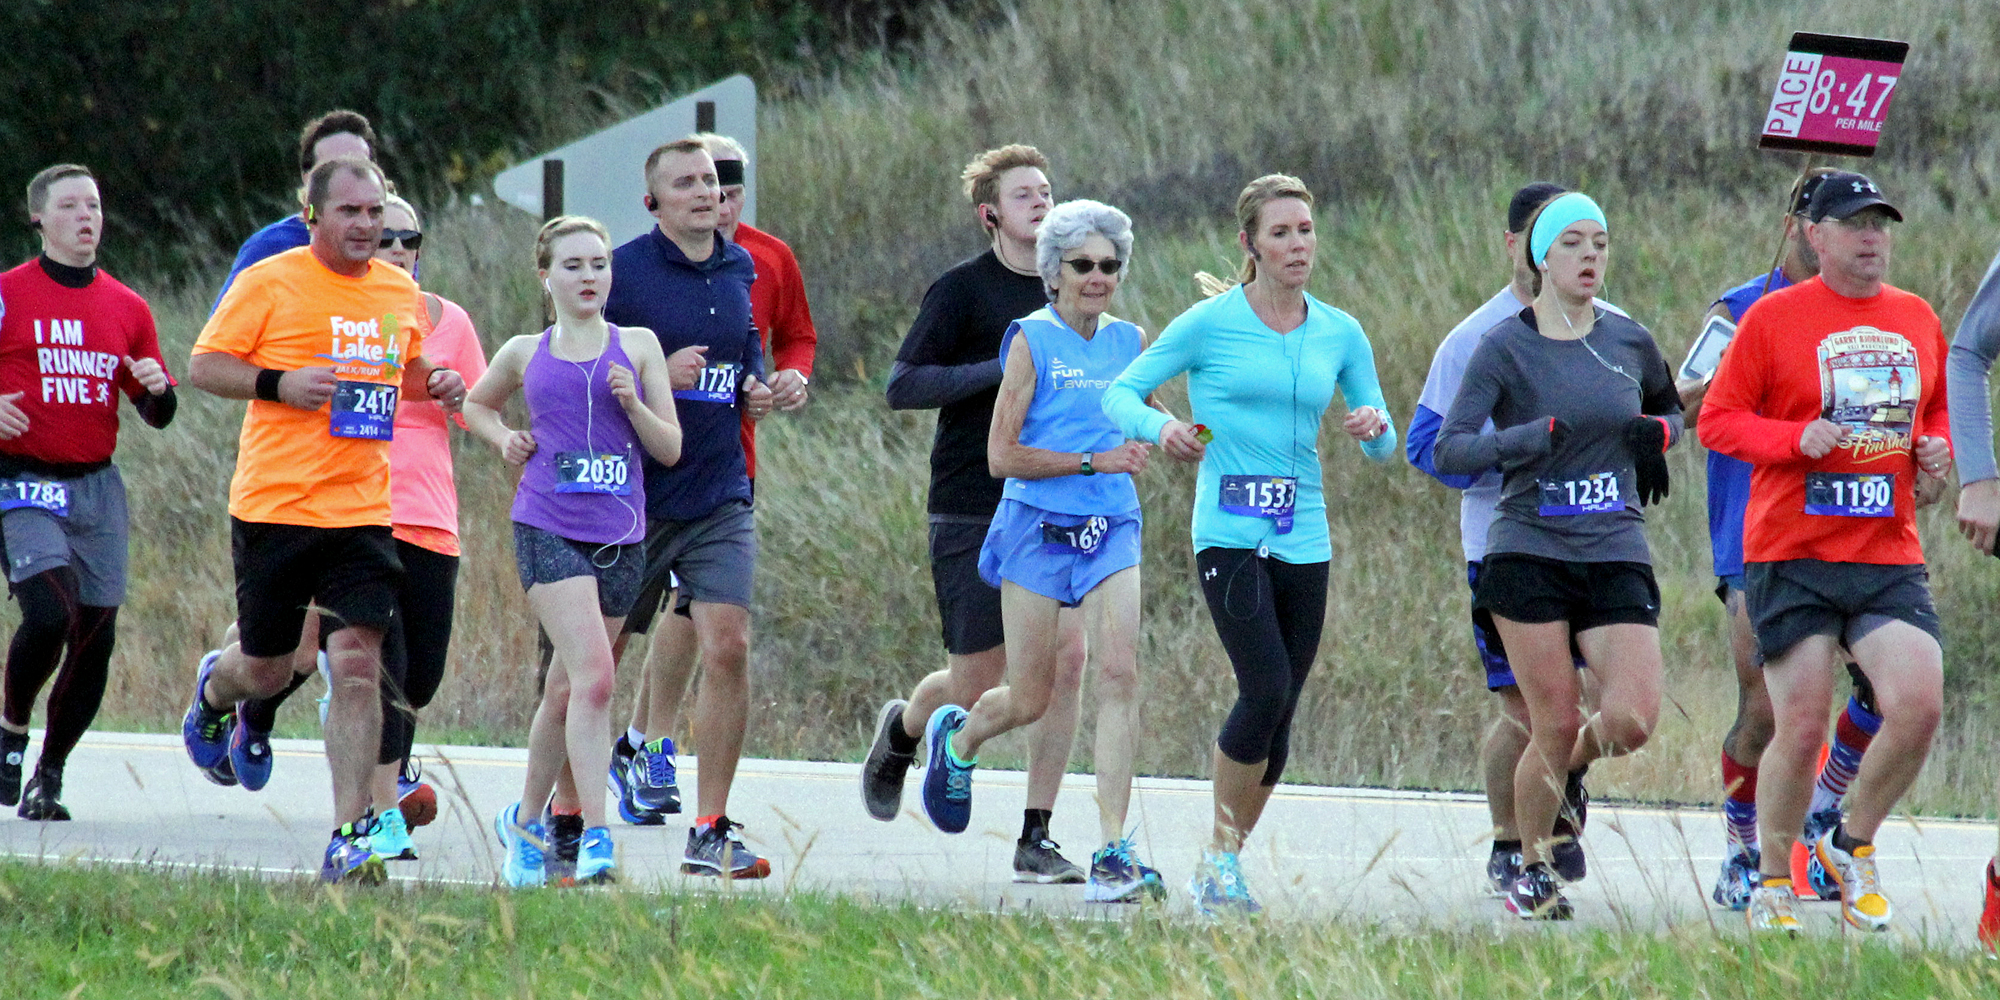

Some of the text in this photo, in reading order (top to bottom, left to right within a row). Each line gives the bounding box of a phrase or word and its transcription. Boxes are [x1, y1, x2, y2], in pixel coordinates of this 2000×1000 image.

[1767, 59, 1815, 134] PACE
[1809, 69, 1898, 119] 8:47
[1835, 117, 1883, 132] PER MILE
[34, 320, 83, 346] I AM
[330, 316, 380, 338] Foot
[332, 338, 384, 361] Lake
[1834, 336, 1857, 346] GARRY
[37, 347, 119, 381] RUNNER
[1051, 368, 1084, 379] run
[42, 377, 92, 405] FIVE
[699, 368, 735, 392] 1724
[354, 388, 396, 416] 2414
[359, 424, 378, 436] 2414
[576, 458, 627, 485] 2030
[16, 481, 67, 507] 1784
[1564, 477, 1619, 505] 1234
[1832, 481, 1891, 507] 1190
[1582, 502, 1613, 511] HALF
[1066, 516, 1108, 550] 1659
